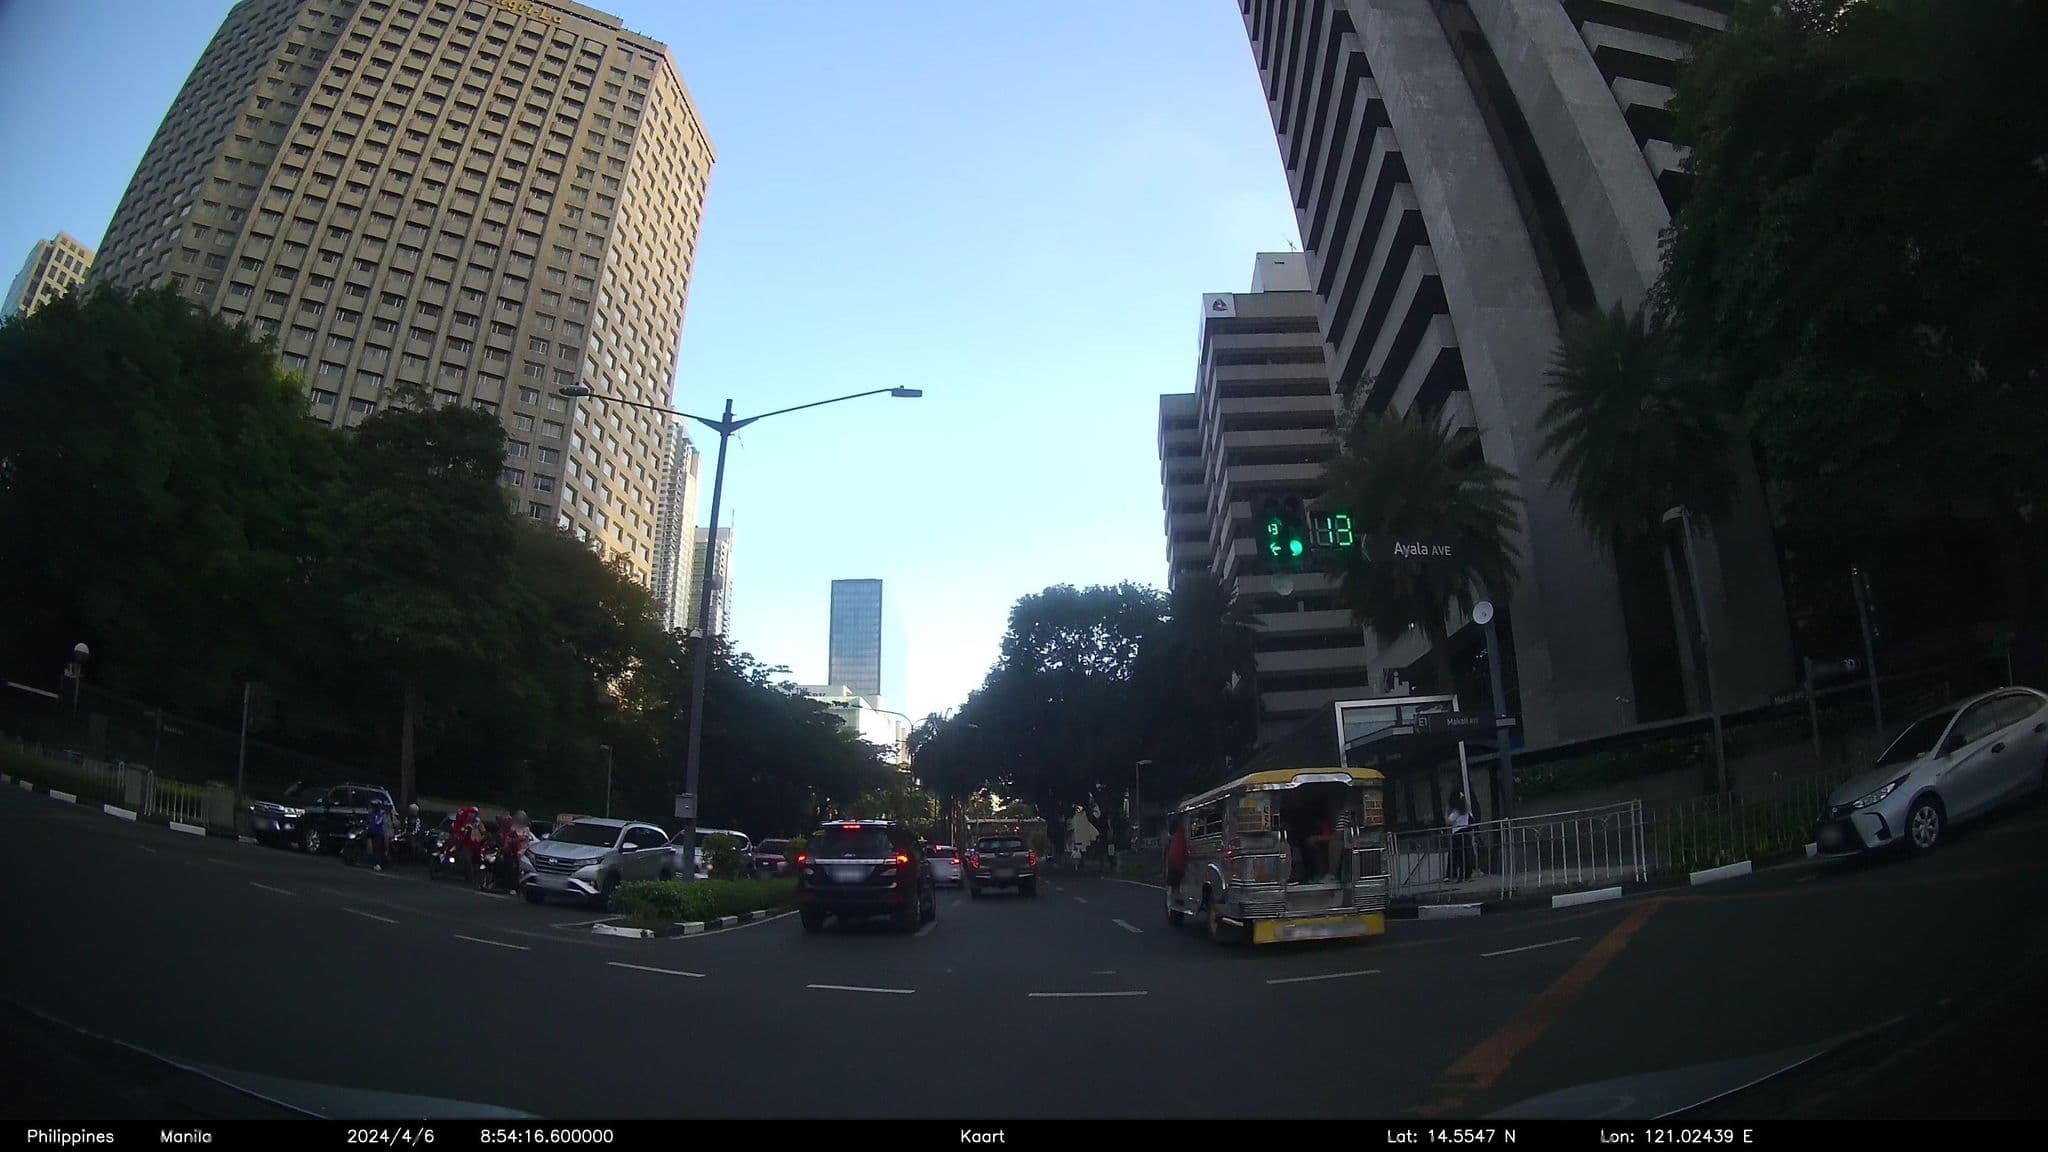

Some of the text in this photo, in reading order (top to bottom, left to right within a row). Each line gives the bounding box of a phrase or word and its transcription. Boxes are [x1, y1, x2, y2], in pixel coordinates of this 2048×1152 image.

[1326, 514, 1354, 546] 13
[1393, 540, 1453, 558] Ayala AVE
